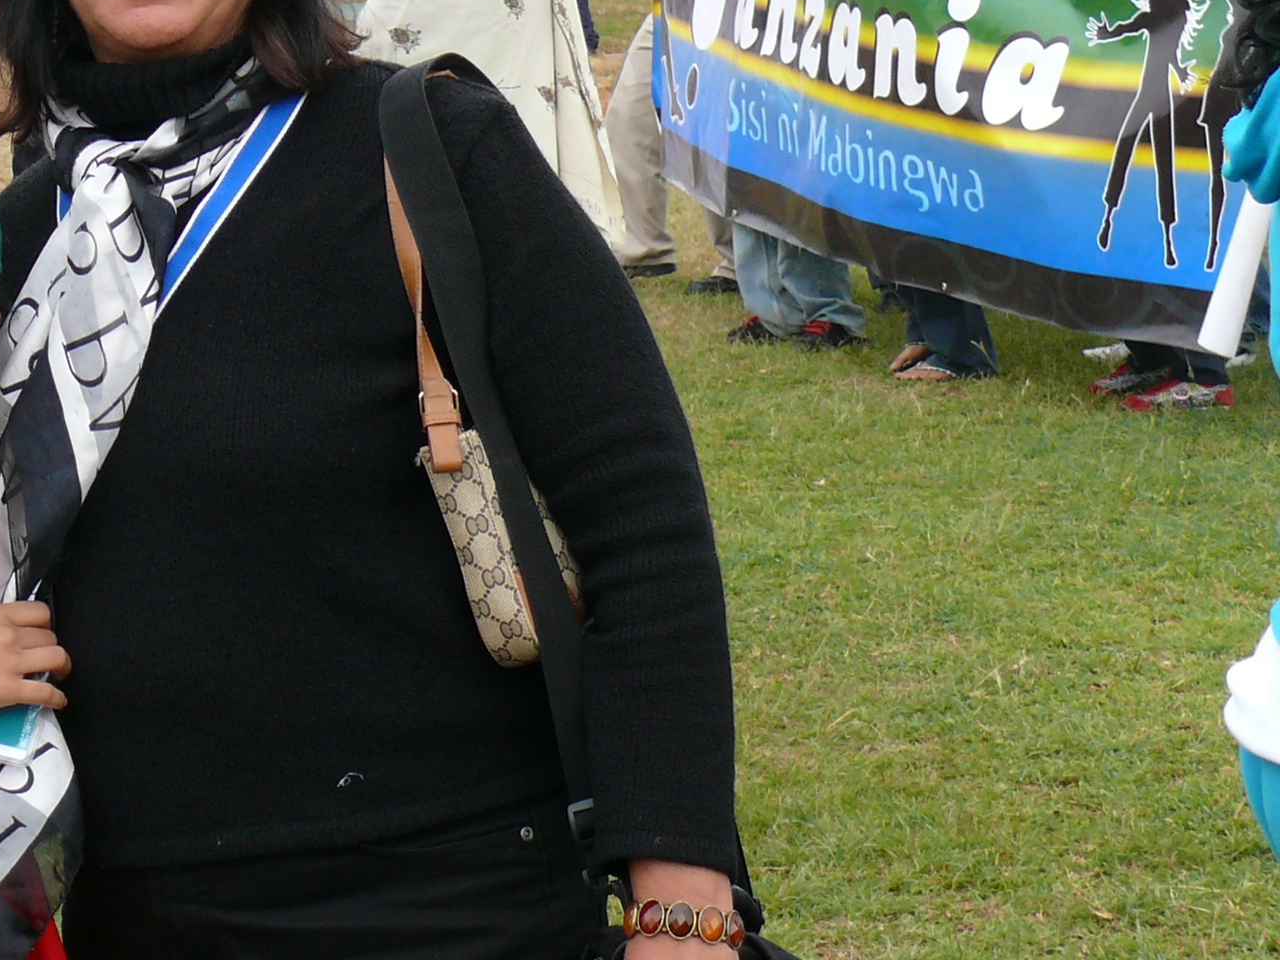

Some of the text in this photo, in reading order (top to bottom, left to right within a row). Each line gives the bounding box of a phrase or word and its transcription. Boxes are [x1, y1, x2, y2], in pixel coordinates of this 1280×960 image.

[727, 78, 985, 213] Sisi ni Mabingwa
